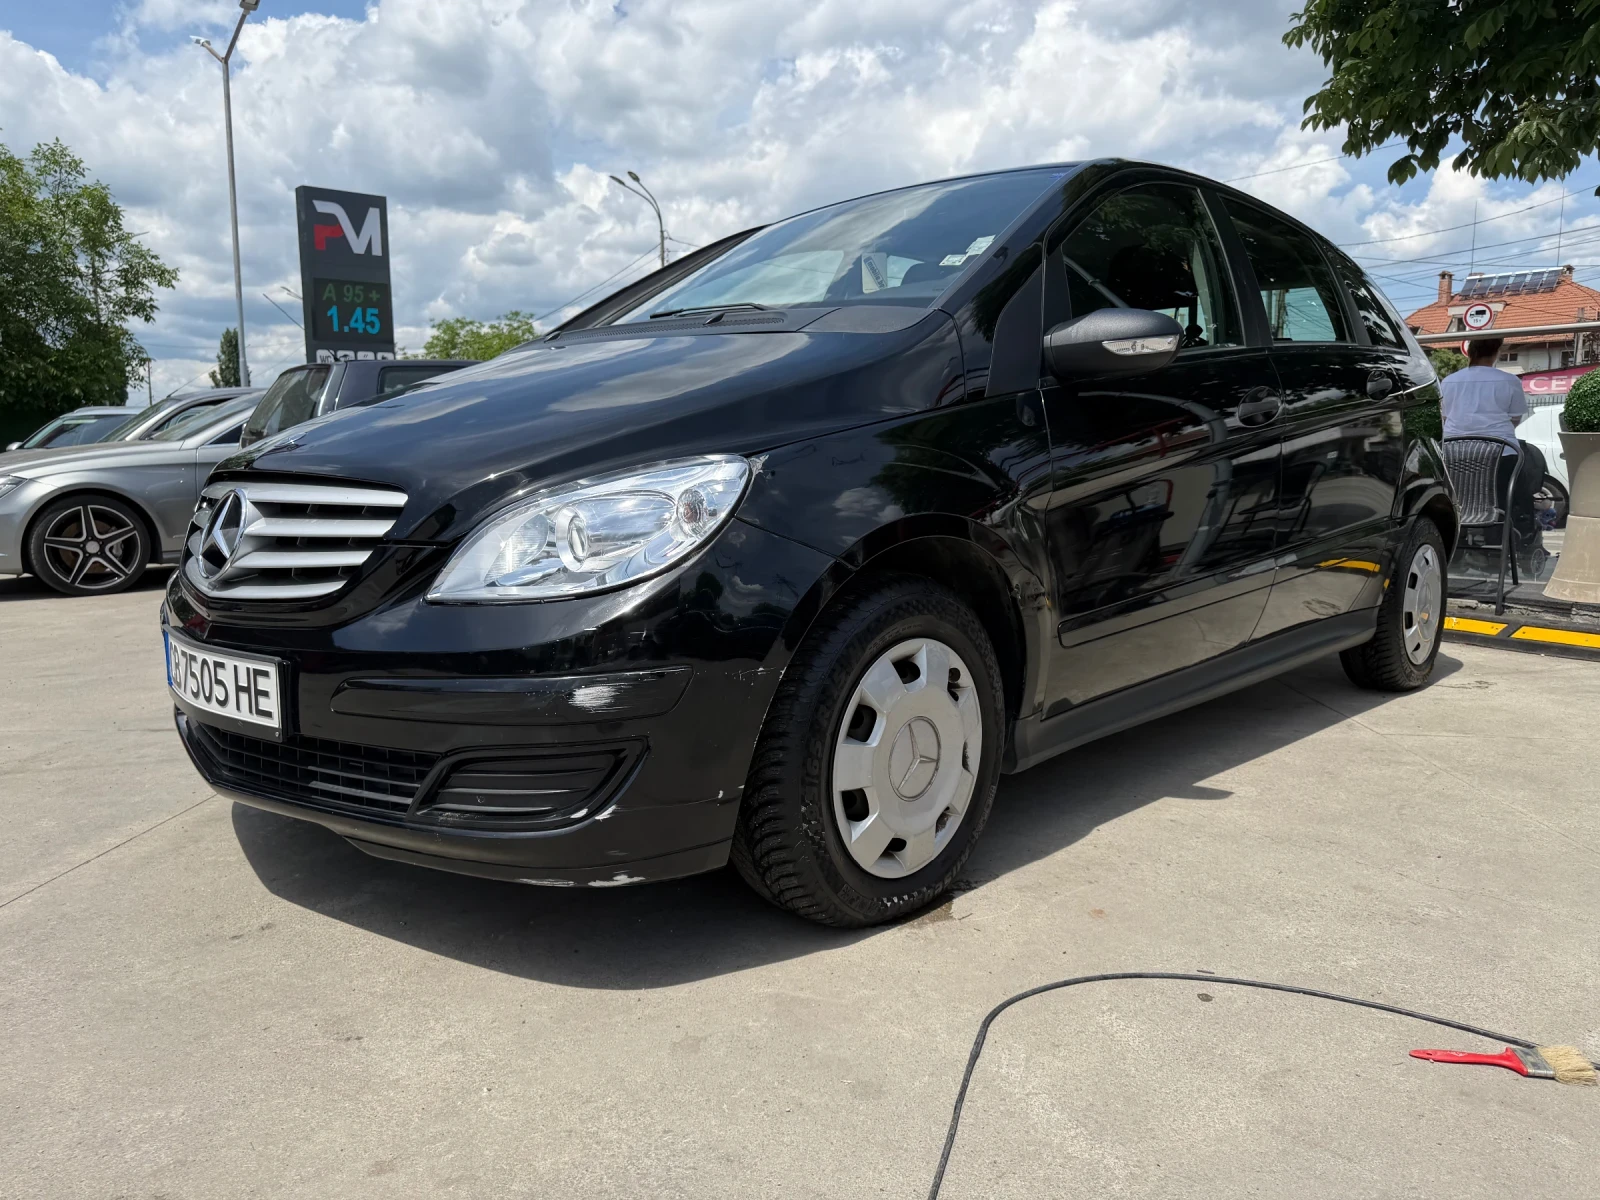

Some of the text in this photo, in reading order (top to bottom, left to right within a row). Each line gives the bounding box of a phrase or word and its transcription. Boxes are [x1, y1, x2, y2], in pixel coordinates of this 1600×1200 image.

[322, 283, 336, 301] A
[327, 304, 381, 334] 1.45
[233, 664, 273, 719] HE
